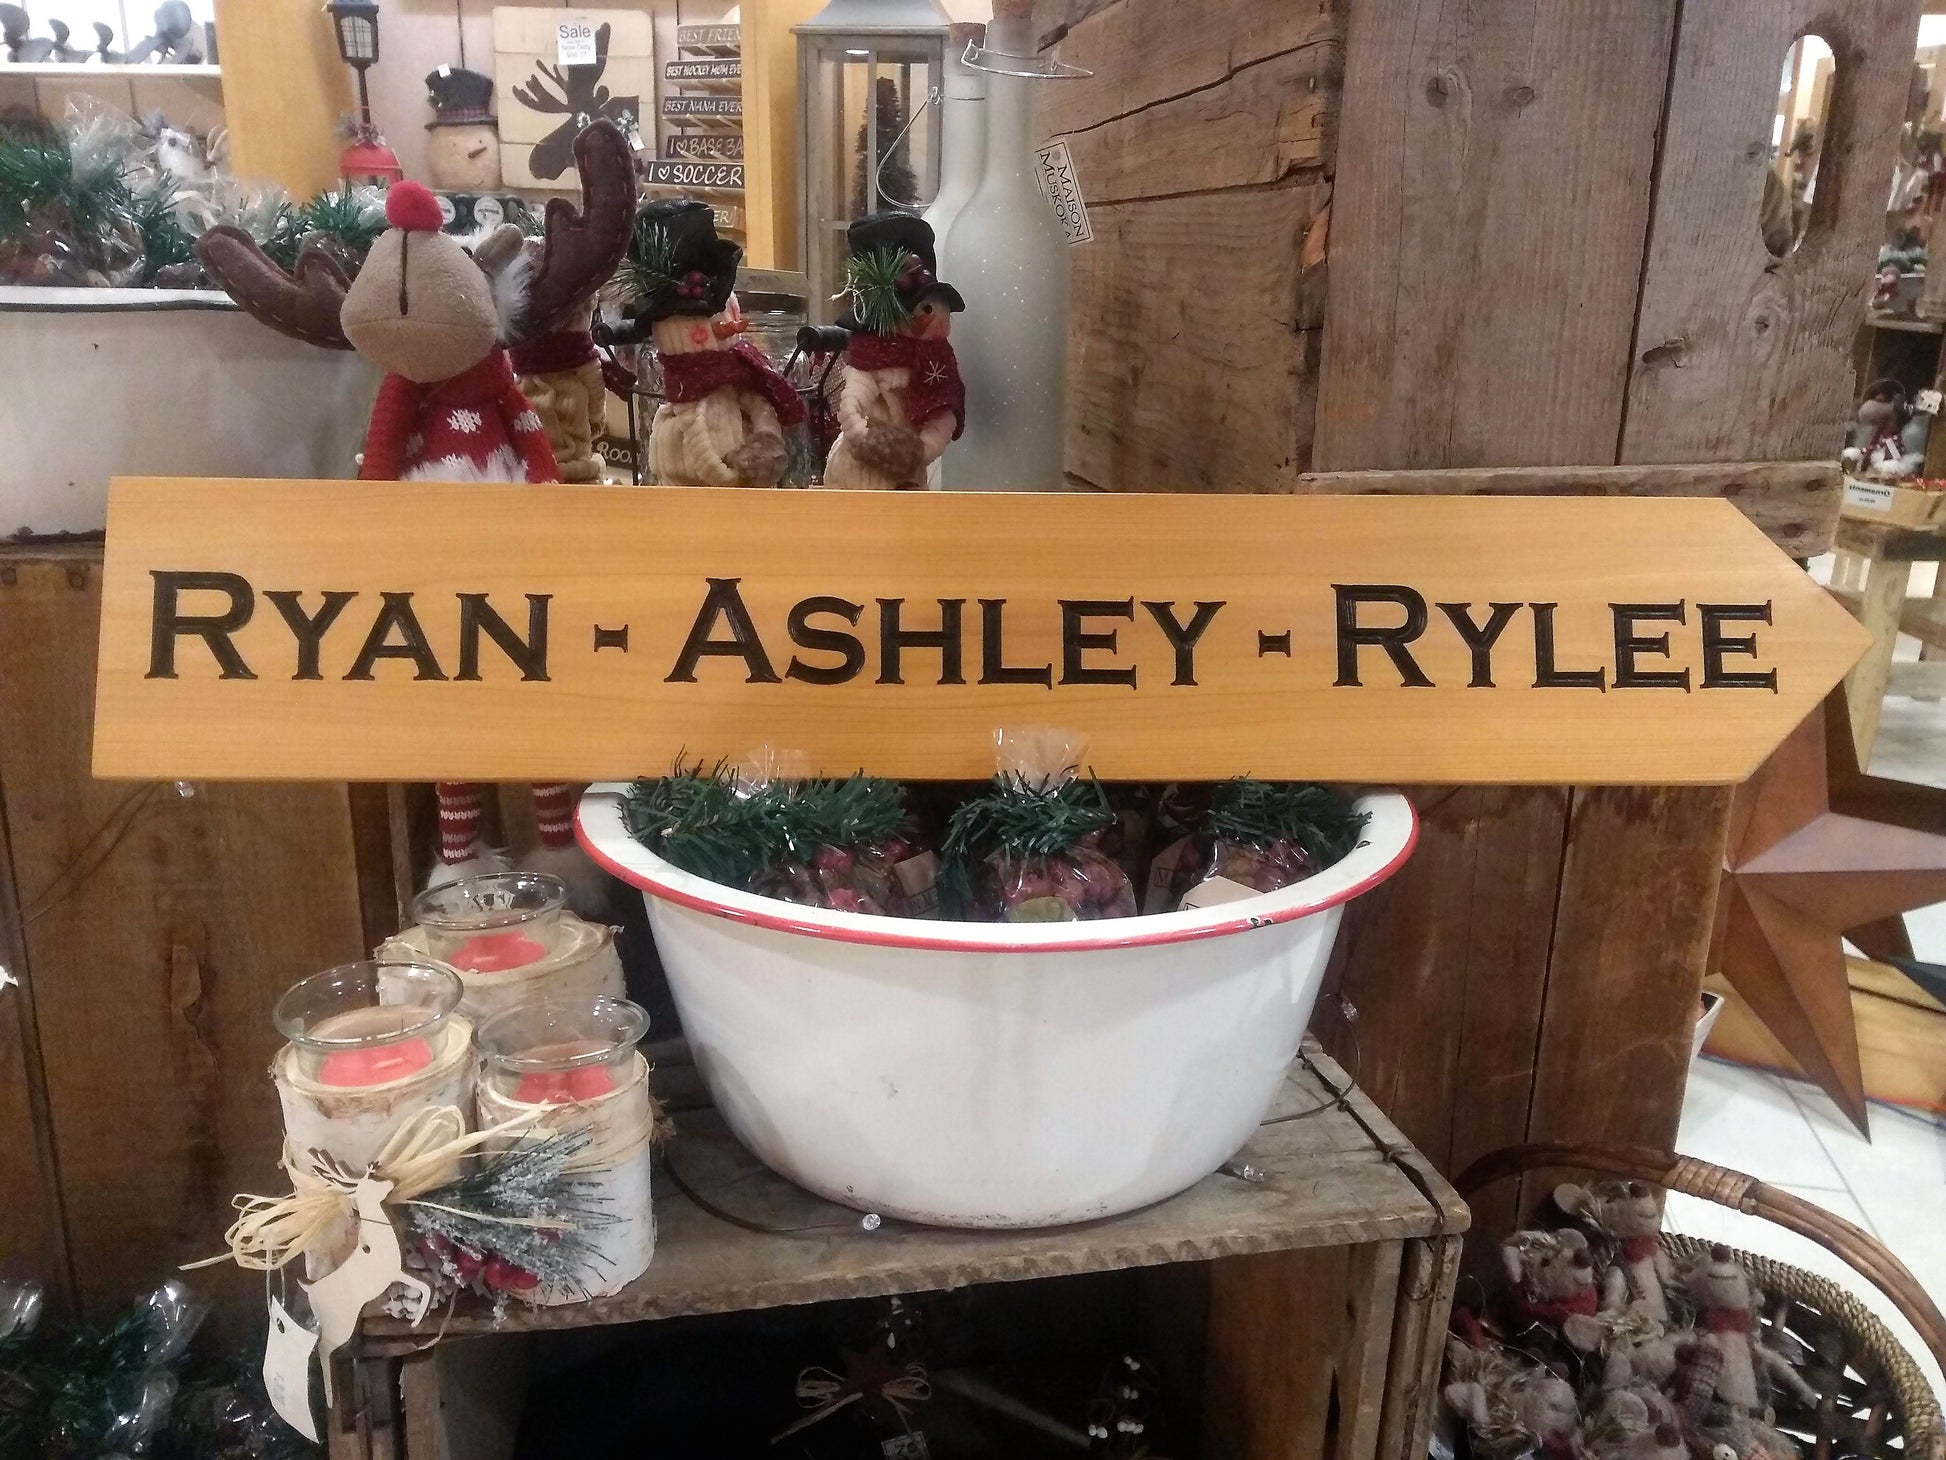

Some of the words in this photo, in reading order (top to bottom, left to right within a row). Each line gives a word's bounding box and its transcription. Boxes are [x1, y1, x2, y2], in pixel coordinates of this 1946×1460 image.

[559, 24, 591, 39] Sale
[679, 28, 704, 42] BEST
[666, 65, 683, 77] BEST
[683, 64, 711, 76] HOCKEY
[711, 63, 729, 75] MOM
[665, 100, 688, 112] BEST
[688, 100, 716, 112] NANA
[718, 101, 742, 112] EVER
[648, 163, 654, 182] I
[673, 164, 743, 186] SOCCER
[1057, 163, 1084, 237] MAISON
[144, 570, 553, 682] RYAN
[664, 577, 1227, 690] ASHLEY
[1330, 583, 1779, 694] RYLEE
